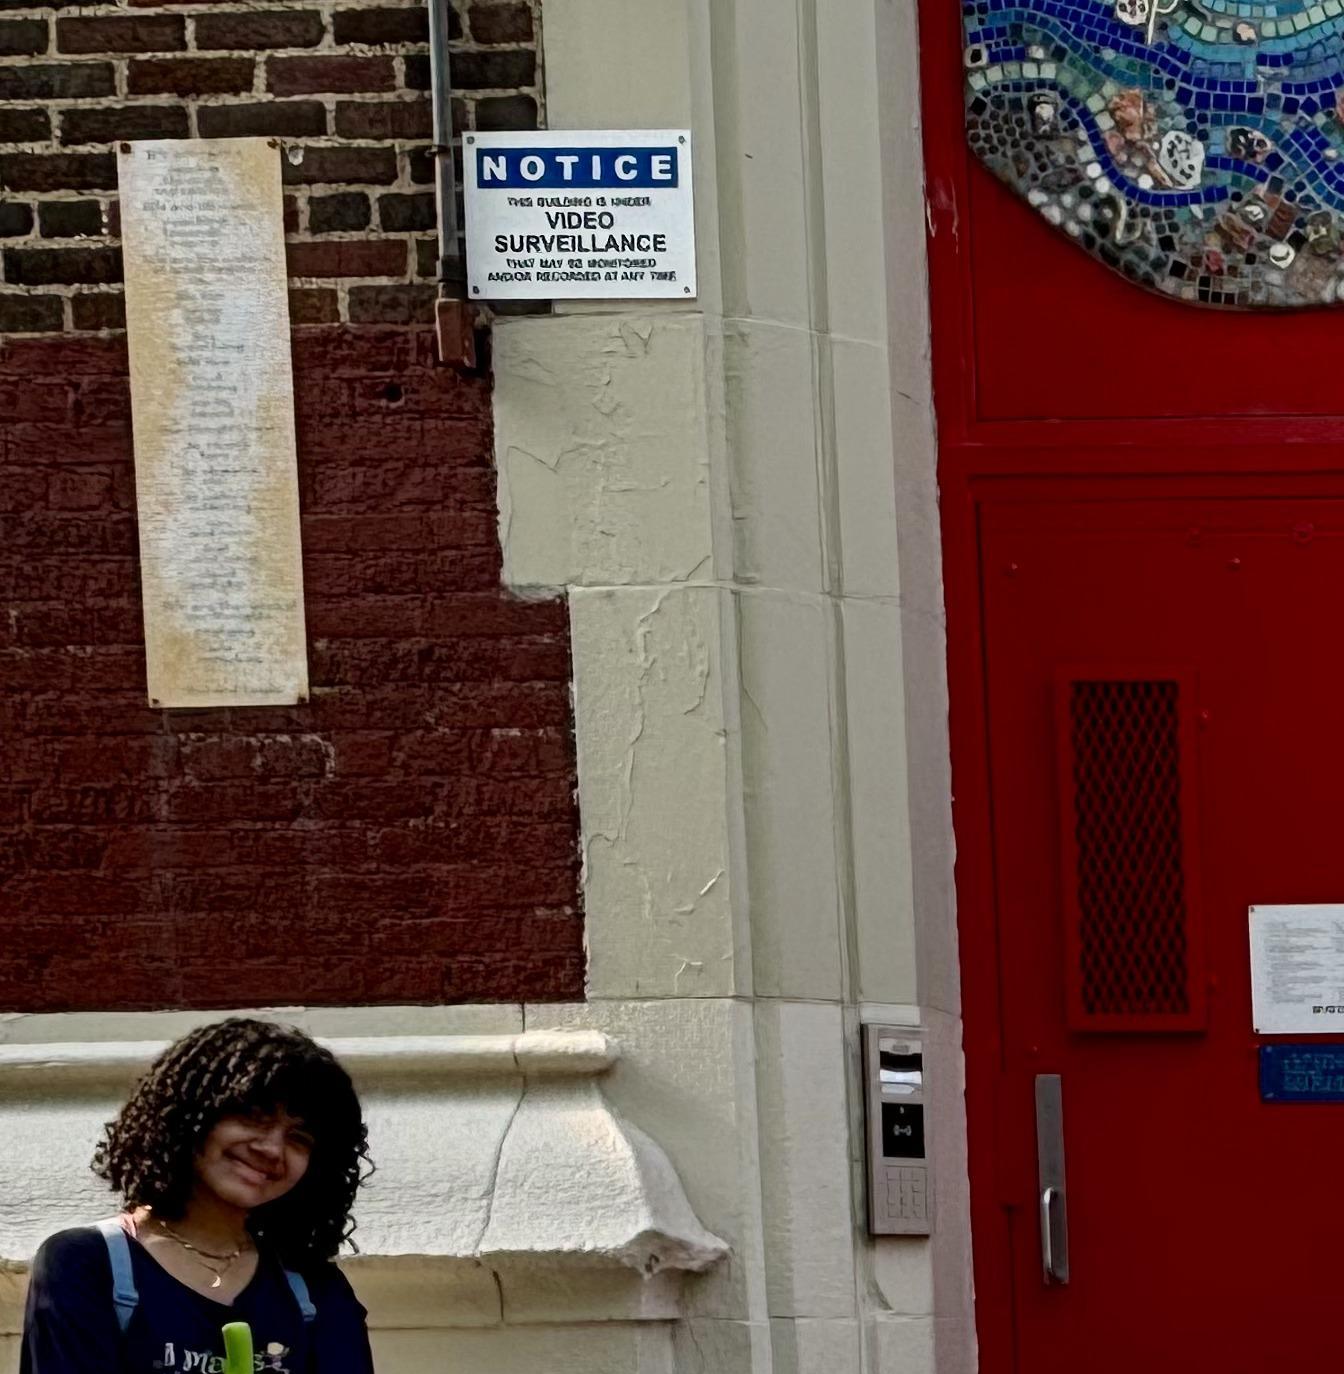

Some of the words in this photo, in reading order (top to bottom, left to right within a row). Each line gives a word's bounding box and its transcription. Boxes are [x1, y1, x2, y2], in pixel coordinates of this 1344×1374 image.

[482, 155, 672, 181] NOTICE
[545, 211, 614, 229] VIDEO
[494, 234, 667, 253] SURVEILLANCE
